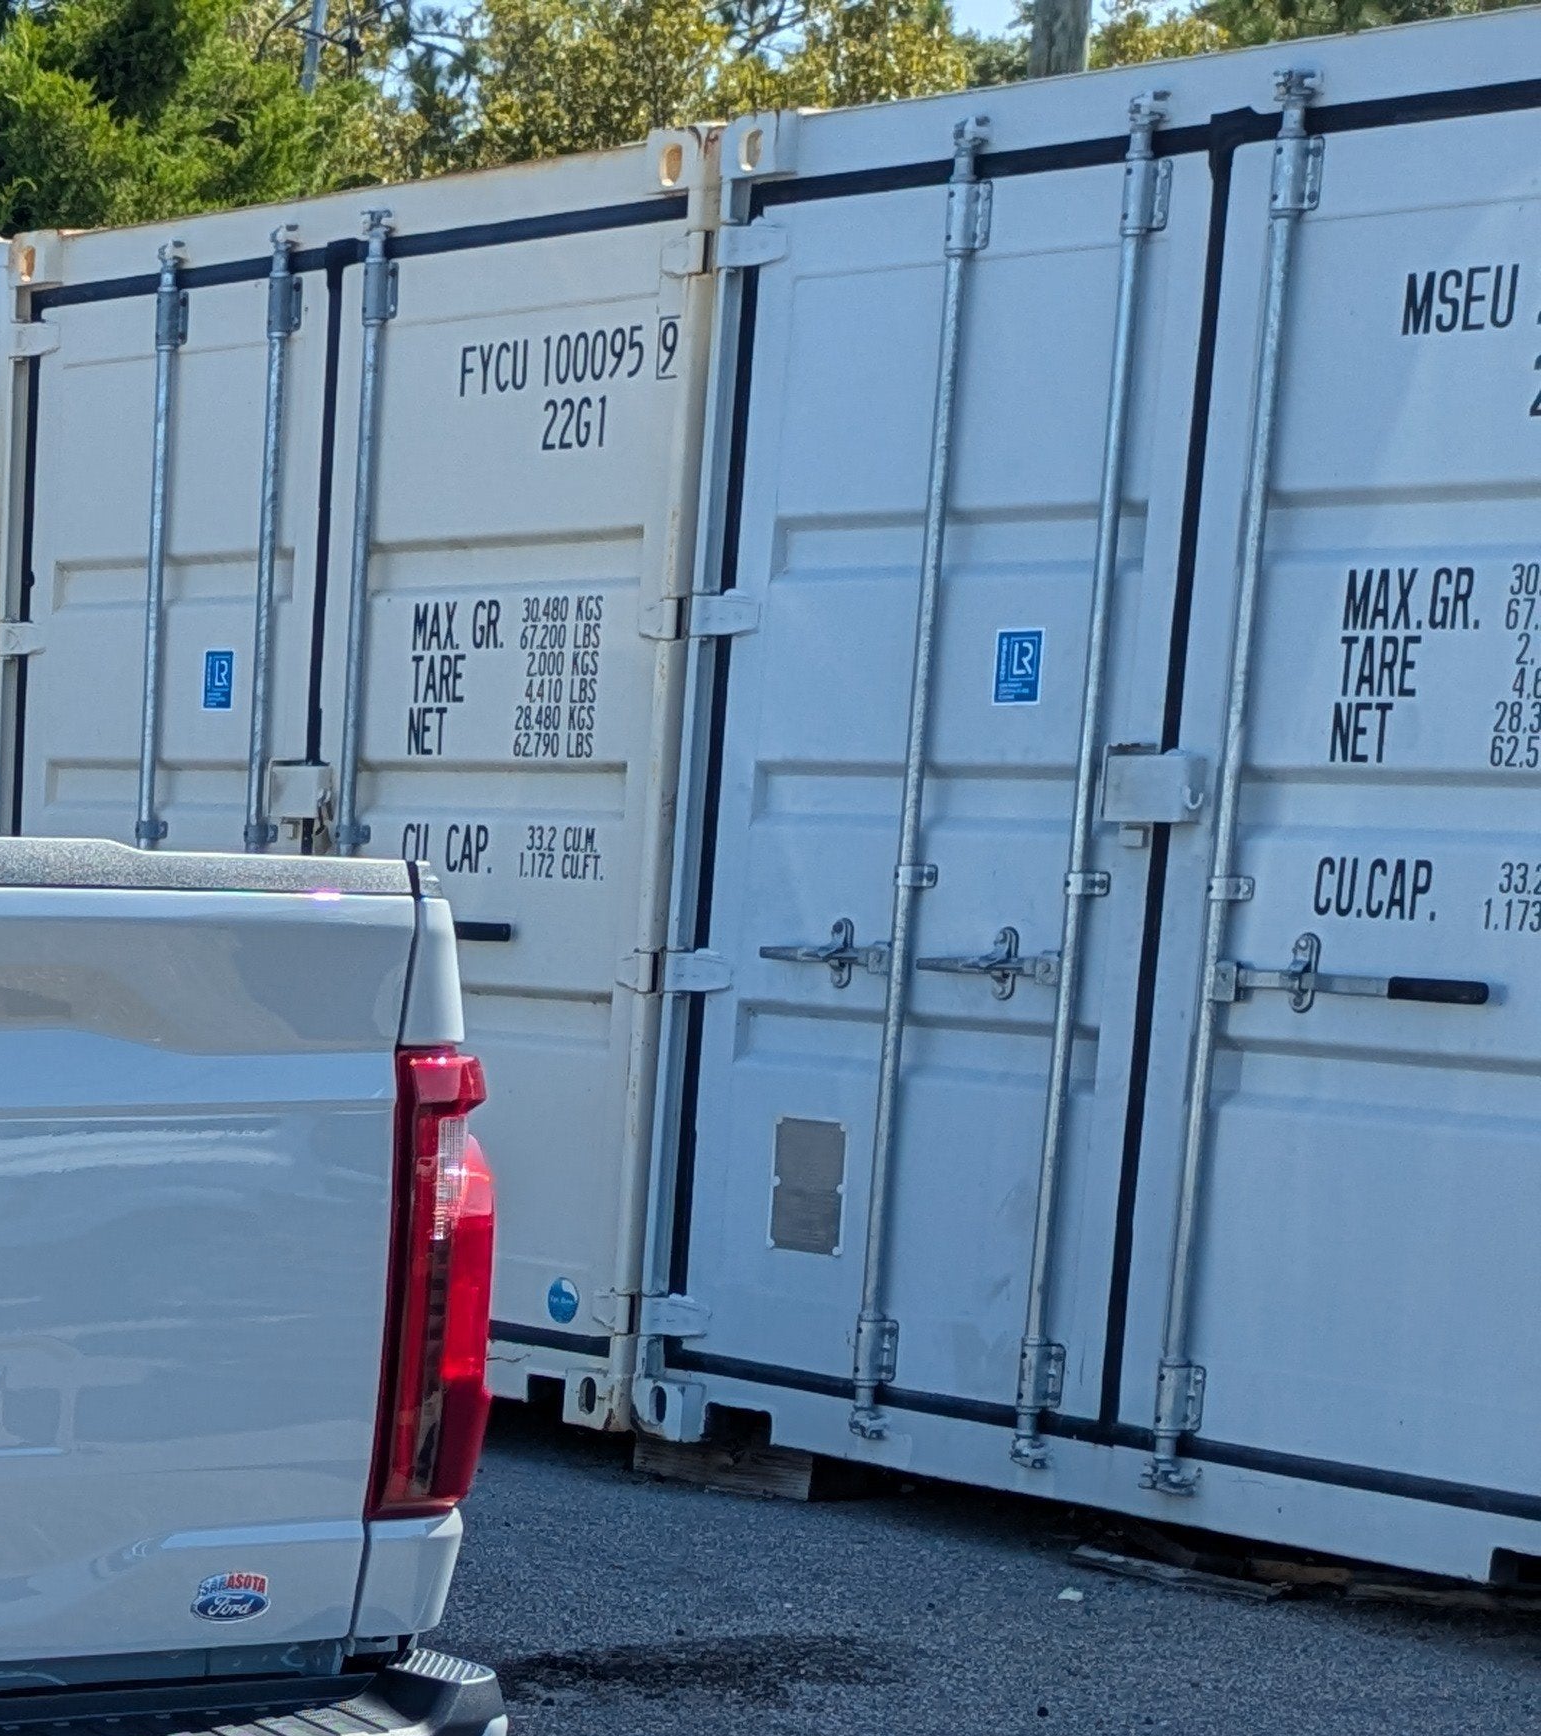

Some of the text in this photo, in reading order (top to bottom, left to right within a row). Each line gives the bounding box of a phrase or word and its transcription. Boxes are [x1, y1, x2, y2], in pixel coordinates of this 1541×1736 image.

[1402, 263, 1520, 335] MSEU
[459, 320, 679, 397] FYCU 100095 9
[541, 394, 607, 451] 22G1
[574, 594, 604, 622] KGS
[1342, 565, 1481, 632] MAX.GR.
[411, 599, 505, 651] MAX. GR.
[572, 622, 602, 650] LBS
[411, 653, 467, 704] TARE
[570, 649, 600, 676] KGS
[1342, 635, 1419, 700] TARE
[568, 677, 598, 704] LBS
[406, 706, 448, 756] NET
[567, 704, 596, 731] KGS
[1329, 701, 1394, 764] NET
[566, 731, 594, 758] LBS
[445, 823, 492, 875] CAP.
[526, 825, 558, 851] 33.2
[1313, 855, 1437, 924] CU.CAP.
[198, 1573, 267, 1596] SARASOTA
[208, 1593, 254, 1617] Ford
